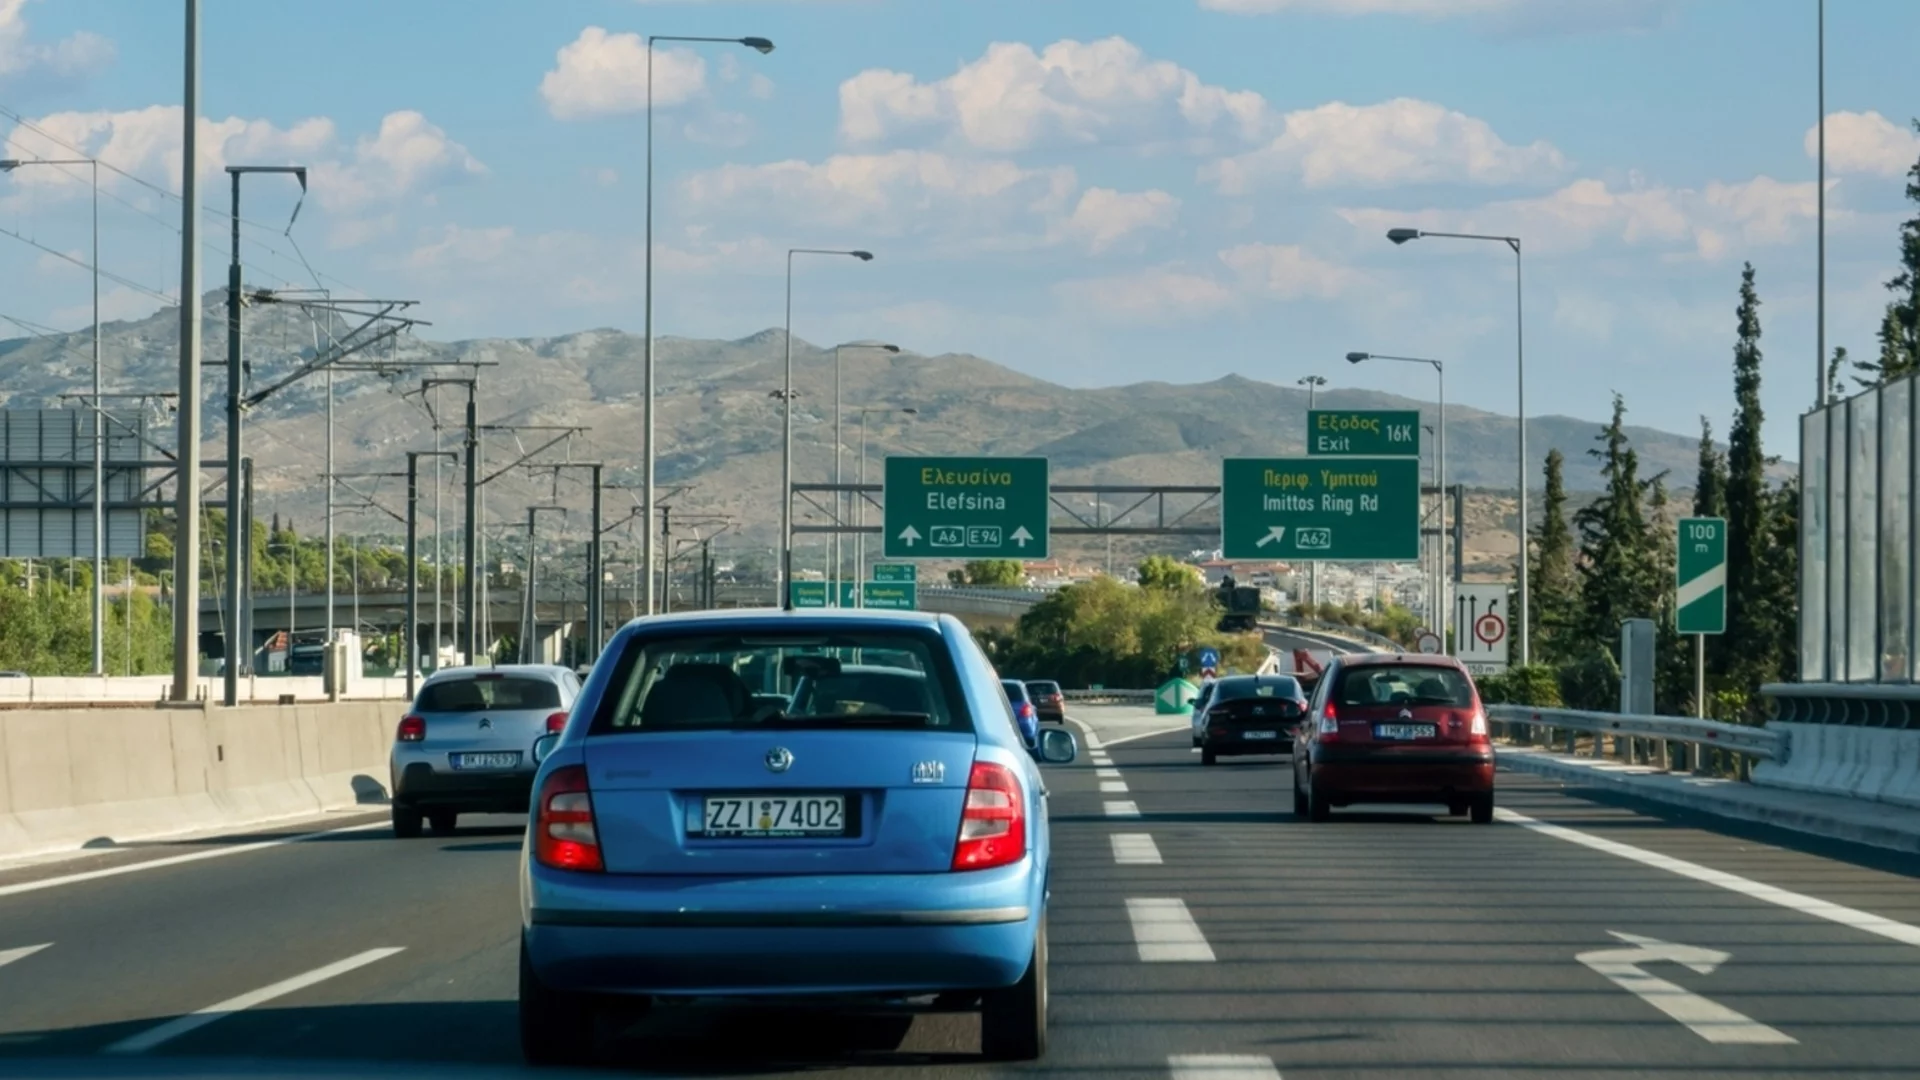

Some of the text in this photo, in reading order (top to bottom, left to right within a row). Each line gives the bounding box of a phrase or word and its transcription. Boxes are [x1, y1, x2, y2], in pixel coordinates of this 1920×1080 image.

[1386, 424, 1412, 442] 16K
[1318, 435, 1350, 451] Exit
[921, 467, 1012, 485] Ελευσίνα
[1264, 469, 1312, 490] Περιφ.
[927, 492, 1006, 510] Elefsina
[1264, 494, 1378, 516] Imittos Ring Rd
[938, 530, 957, 543] A6
[1300, 532, 1328, 545] A62
[1688, 524, 1716, 540] 100
[1695, 543, 1709, 553] m
